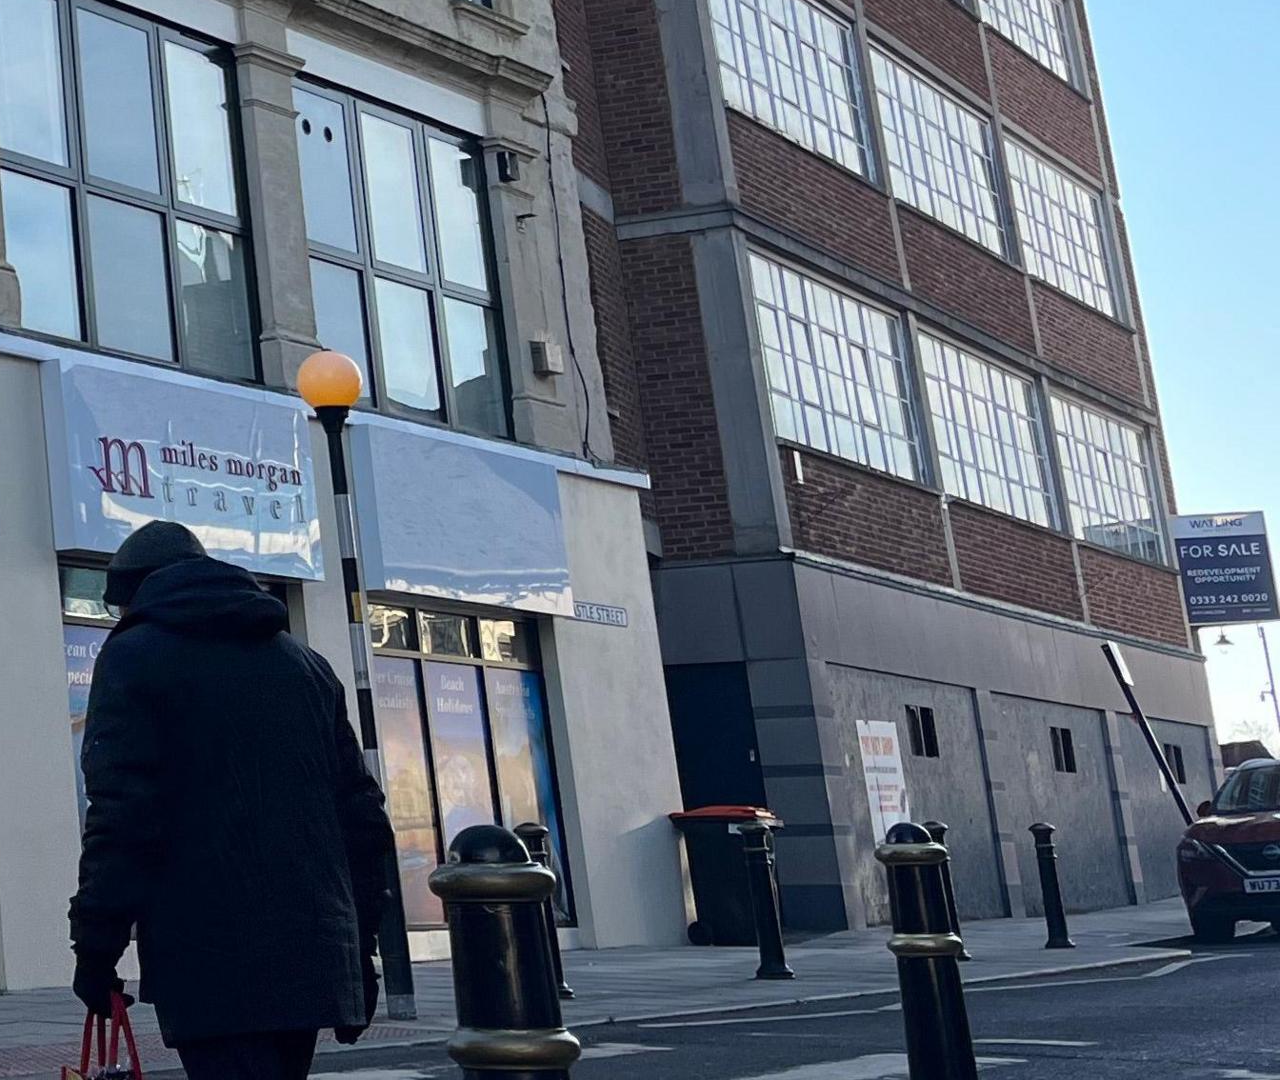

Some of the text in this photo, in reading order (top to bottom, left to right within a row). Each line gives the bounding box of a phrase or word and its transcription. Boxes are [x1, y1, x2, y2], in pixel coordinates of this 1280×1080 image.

[161, 440, 303, 491] miles morgan
[1189, 518, 1242, 529] WATLING
[1180, 542, 1261, 558] FOR SALE
[1187, 566, 1261, 577] REDEVELOPMENT
[1194, 574, 1256, 584] OPPORTUNITY
[1190, 595, 1216, 605] 0333
[1219, 594, 1238, 604] 242
[596, 607, 625, 625] STREET
